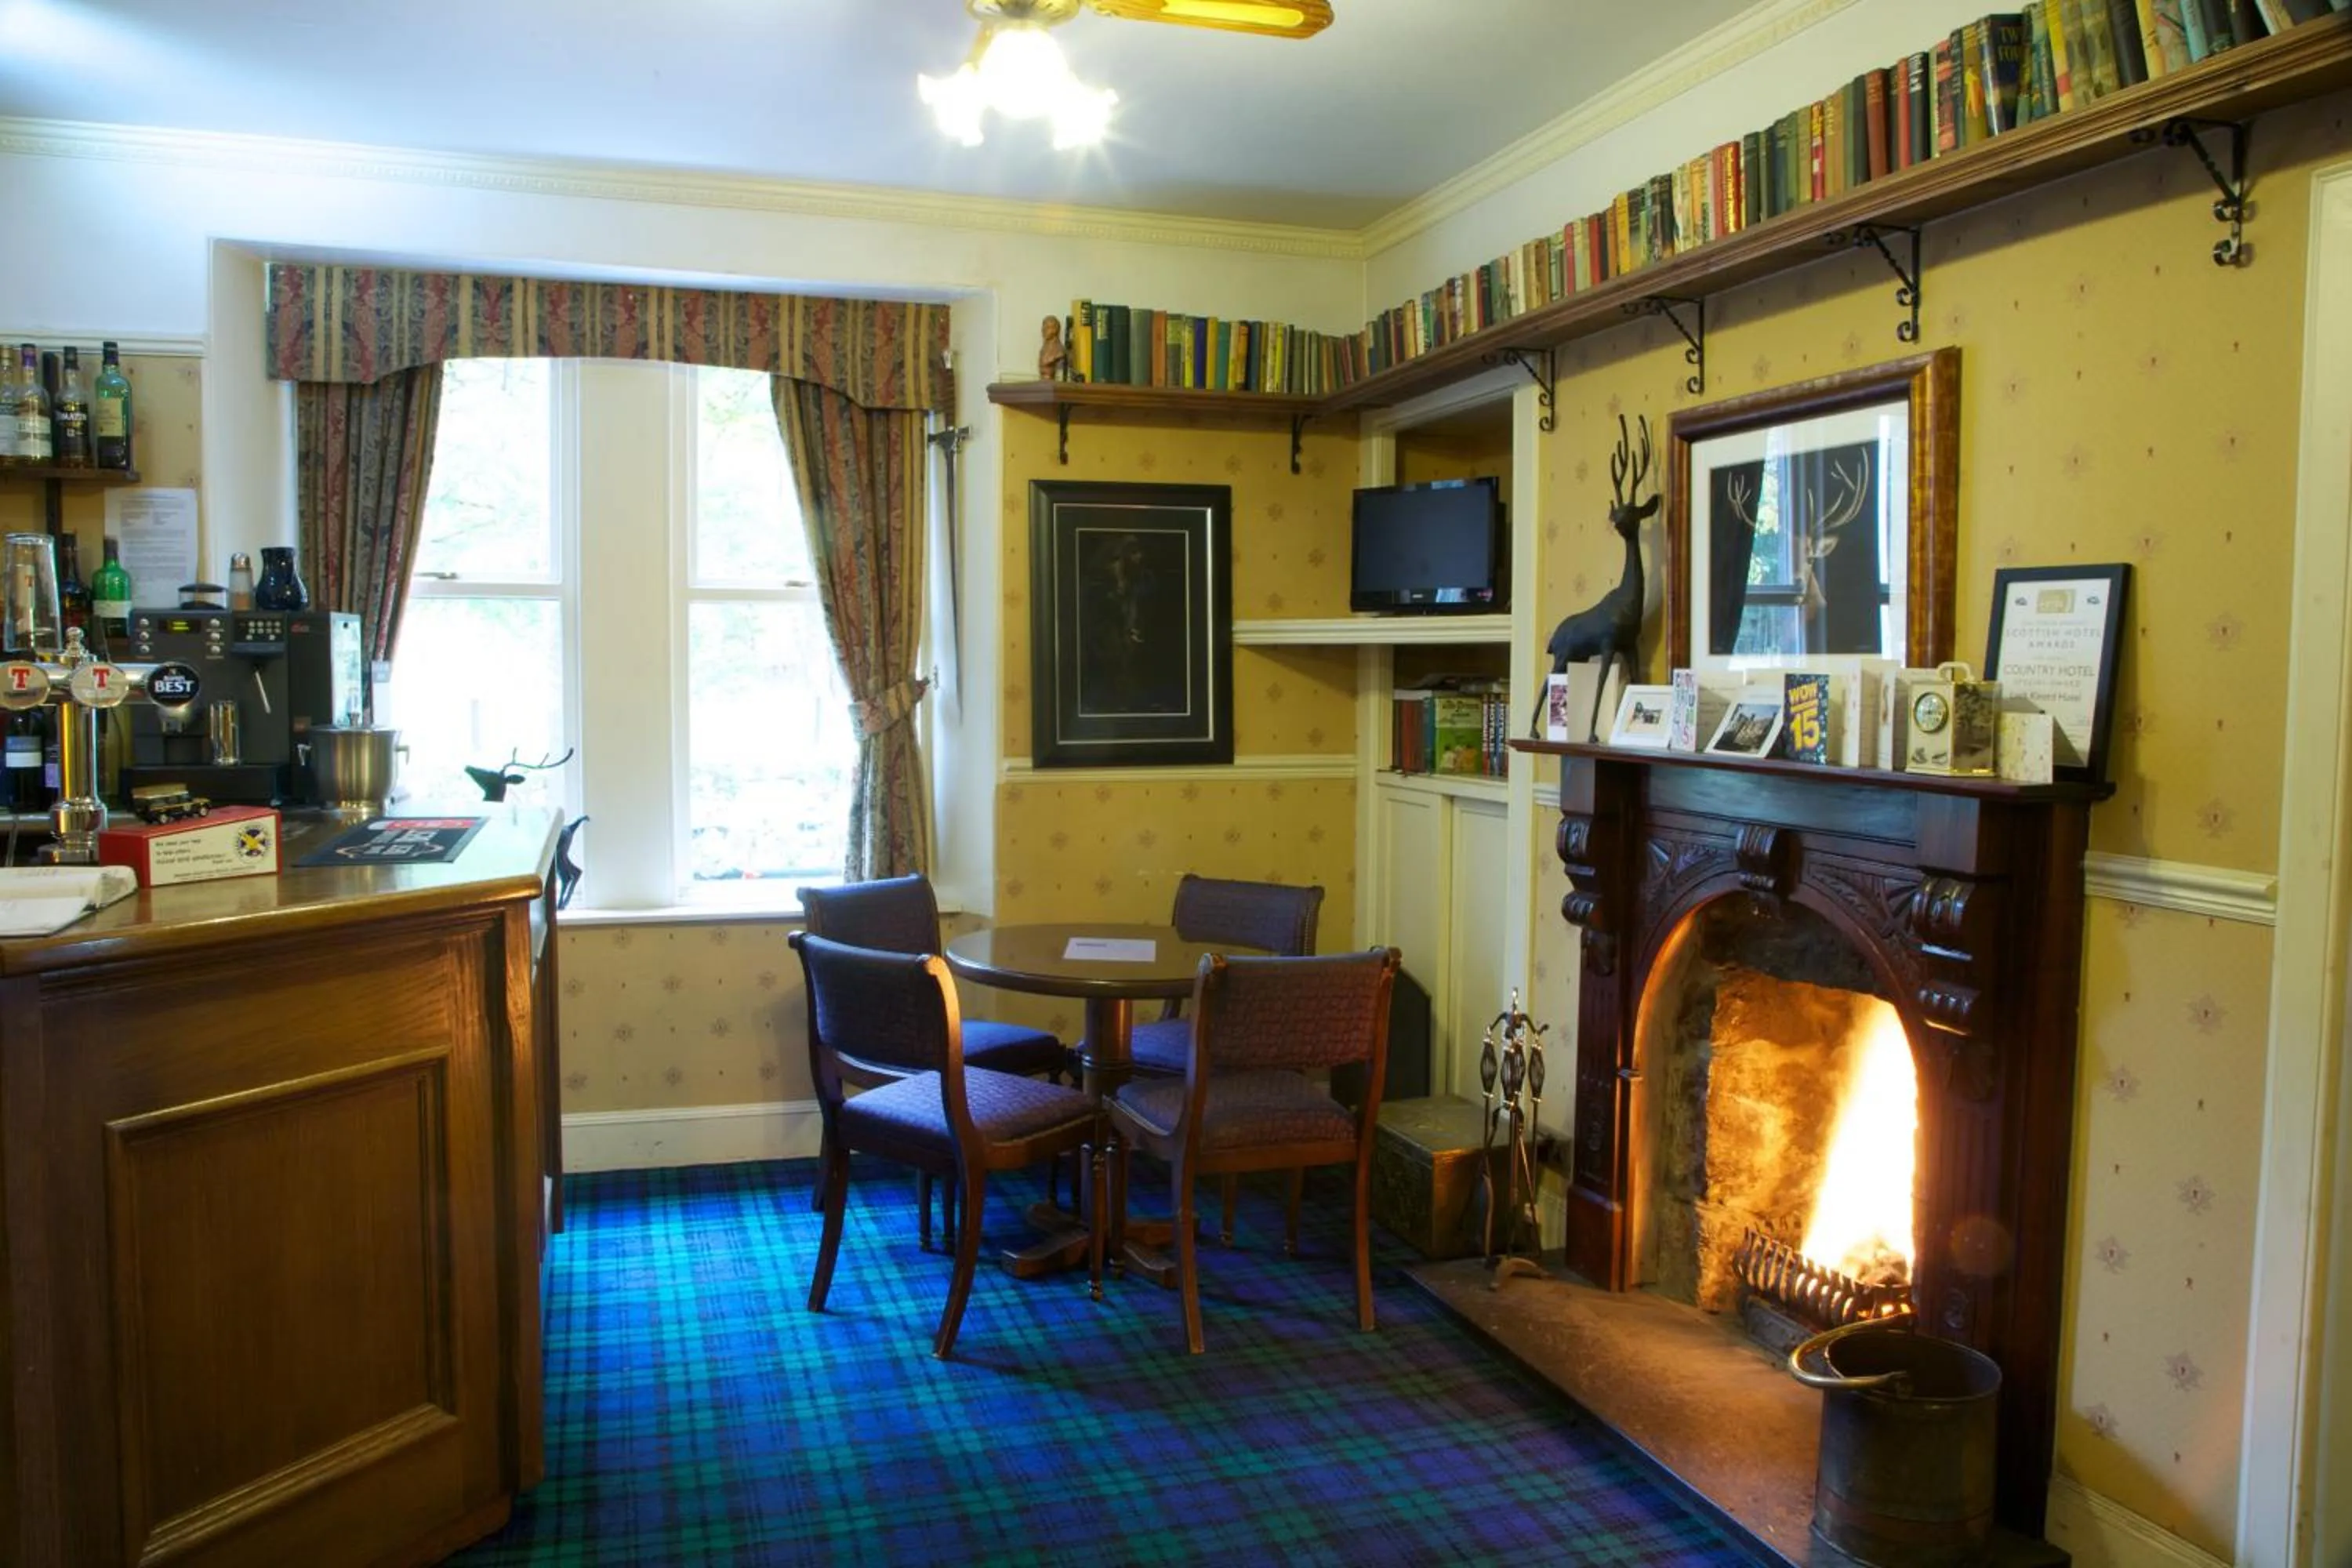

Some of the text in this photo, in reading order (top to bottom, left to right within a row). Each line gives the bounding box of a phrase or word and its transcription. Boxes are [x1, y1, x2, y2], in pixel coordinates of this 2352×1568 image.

[2063, 627, 2101, 638] HOTEL
[2028, 640, 2076, 650] AWARDS
[11, 667, 31, 688] T
[92, 667, 111, 688] T
[2004, 664, 2096, 677] COUNTRY HOTEL
[154, 680, 194, 693] BEST
[1788, 681, 1818, 703] WOW
[1789, 707, 1820, 753] 15
